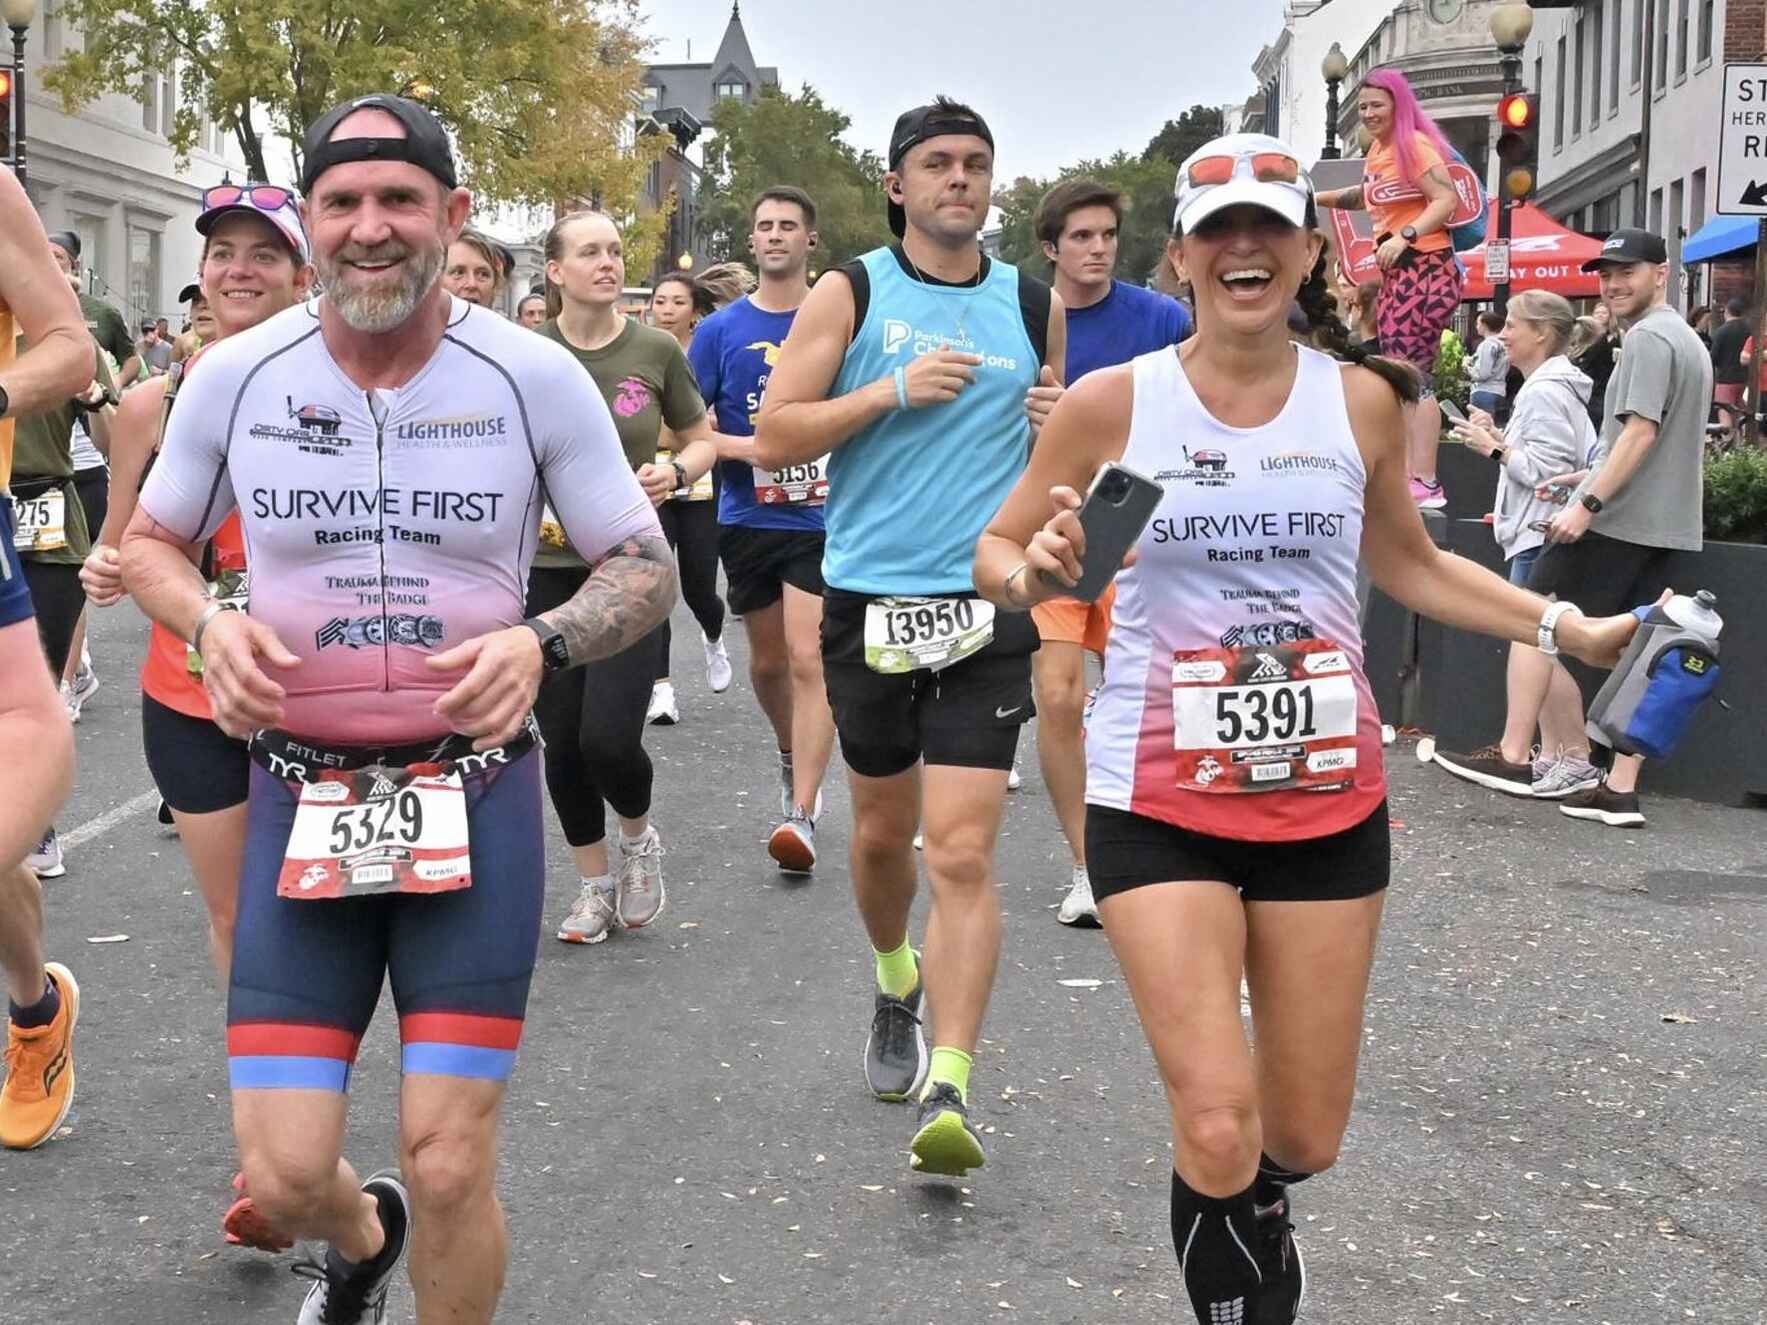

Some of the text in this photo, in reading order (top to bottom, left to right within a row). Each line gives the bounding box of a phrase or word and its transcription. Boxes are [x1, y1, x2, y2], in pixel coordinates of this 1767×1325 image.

[1535, 266, 1569, 278] OUT
[398, 416, 507, 439] LIGHTHOUSE
[1260, 456, 1337, 472] LIGHTHOUSE
[253, 488, 505, 522] SURVIVE FIRST
[315, 525, 441, 546] Racing Team
[1152, 512, 1345, 544] SURVIVE FIRST
[1208, 546, 1311, 563] Racing Team
[885, 599, 974, 646] 13950
[1216, 685, 1317, 744] 5391
[268, 752, 308, 784] TYR
[455, 747, 509, 774] TYR
[1317, 757, 1345, 769] KPMG
[329, 790, 423, 855] 5329
